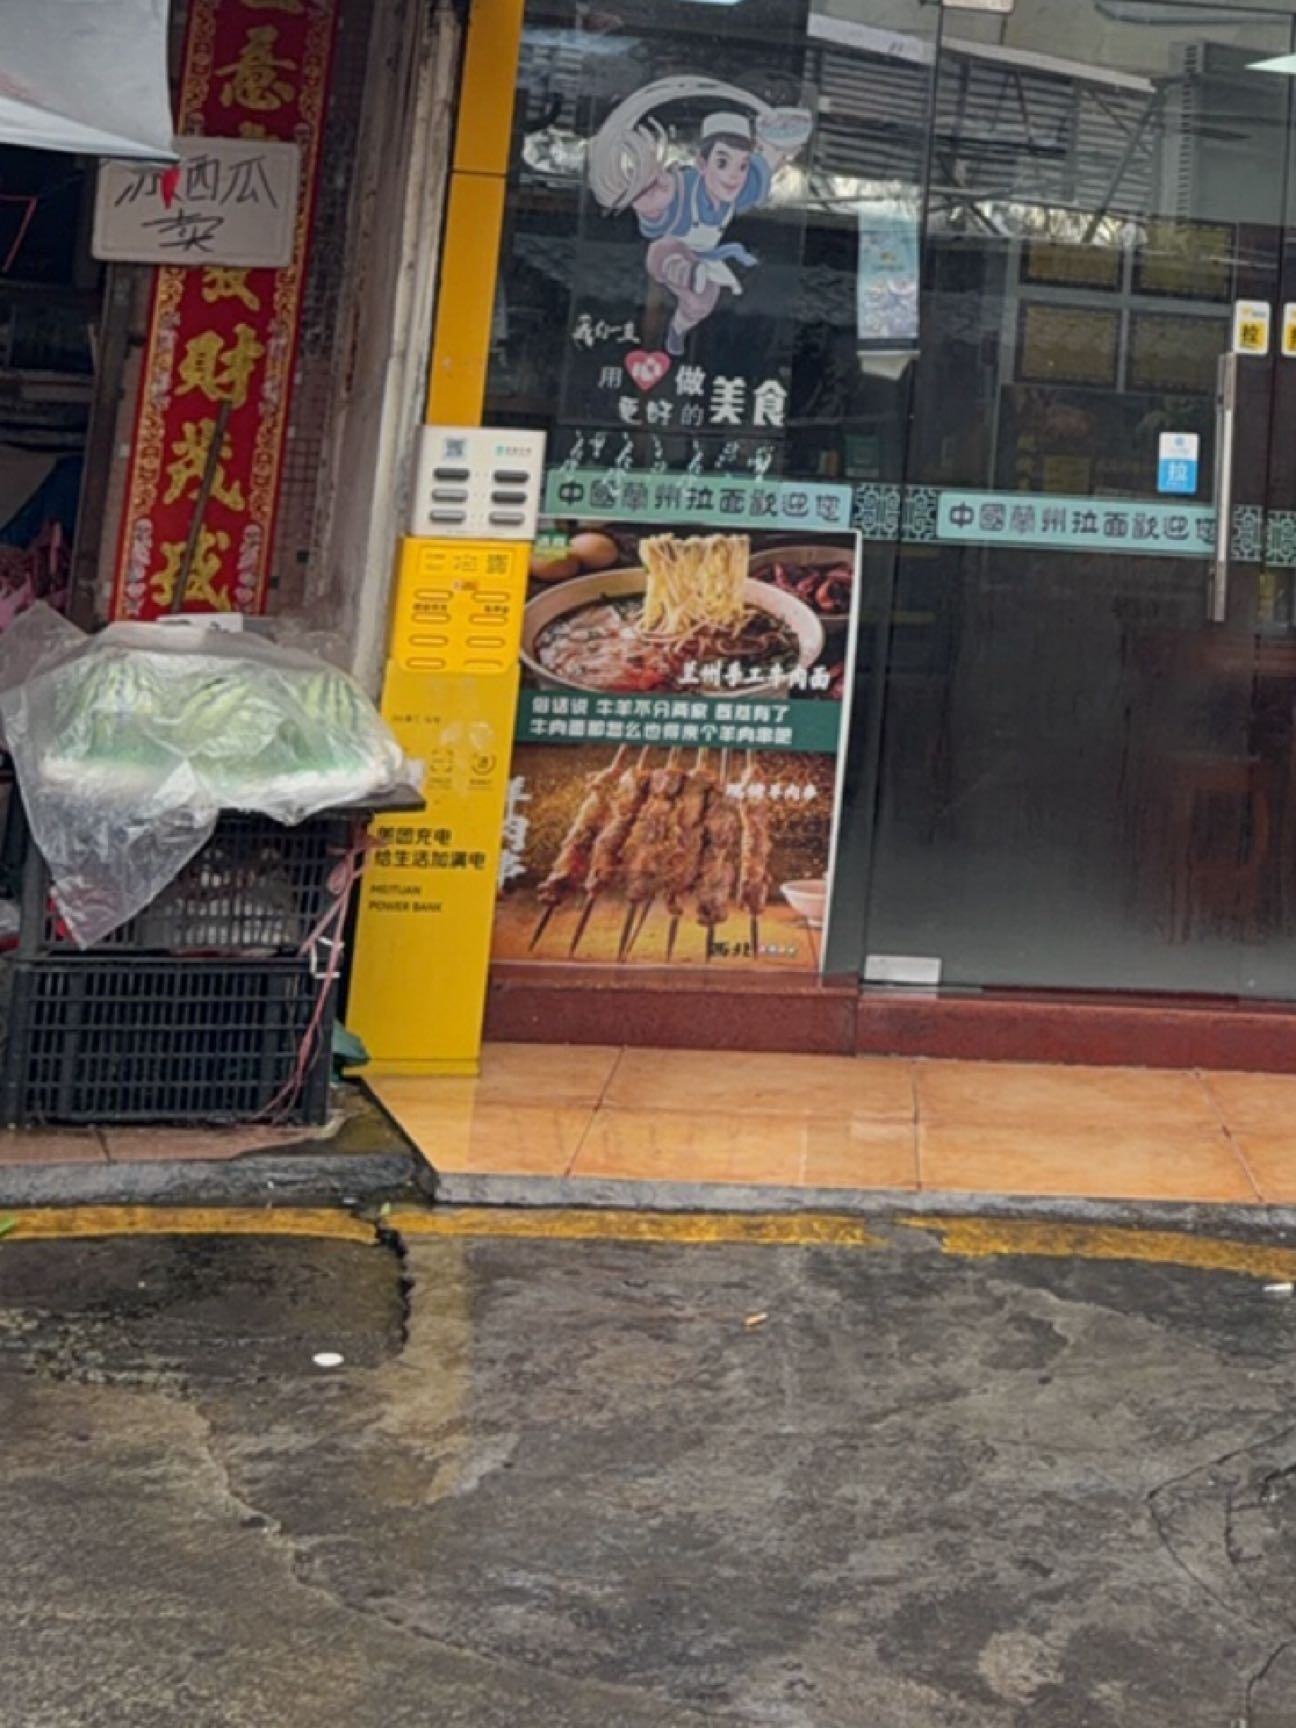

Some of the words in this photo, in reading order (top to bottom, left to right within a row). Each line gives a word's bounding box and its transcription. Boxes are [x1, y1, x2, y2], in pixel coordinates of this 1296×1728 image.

[369, 883, 422, 896] MEITUAN
[368, 900, 411, 912] POWER
[412, 901, 442, 913] BANK
